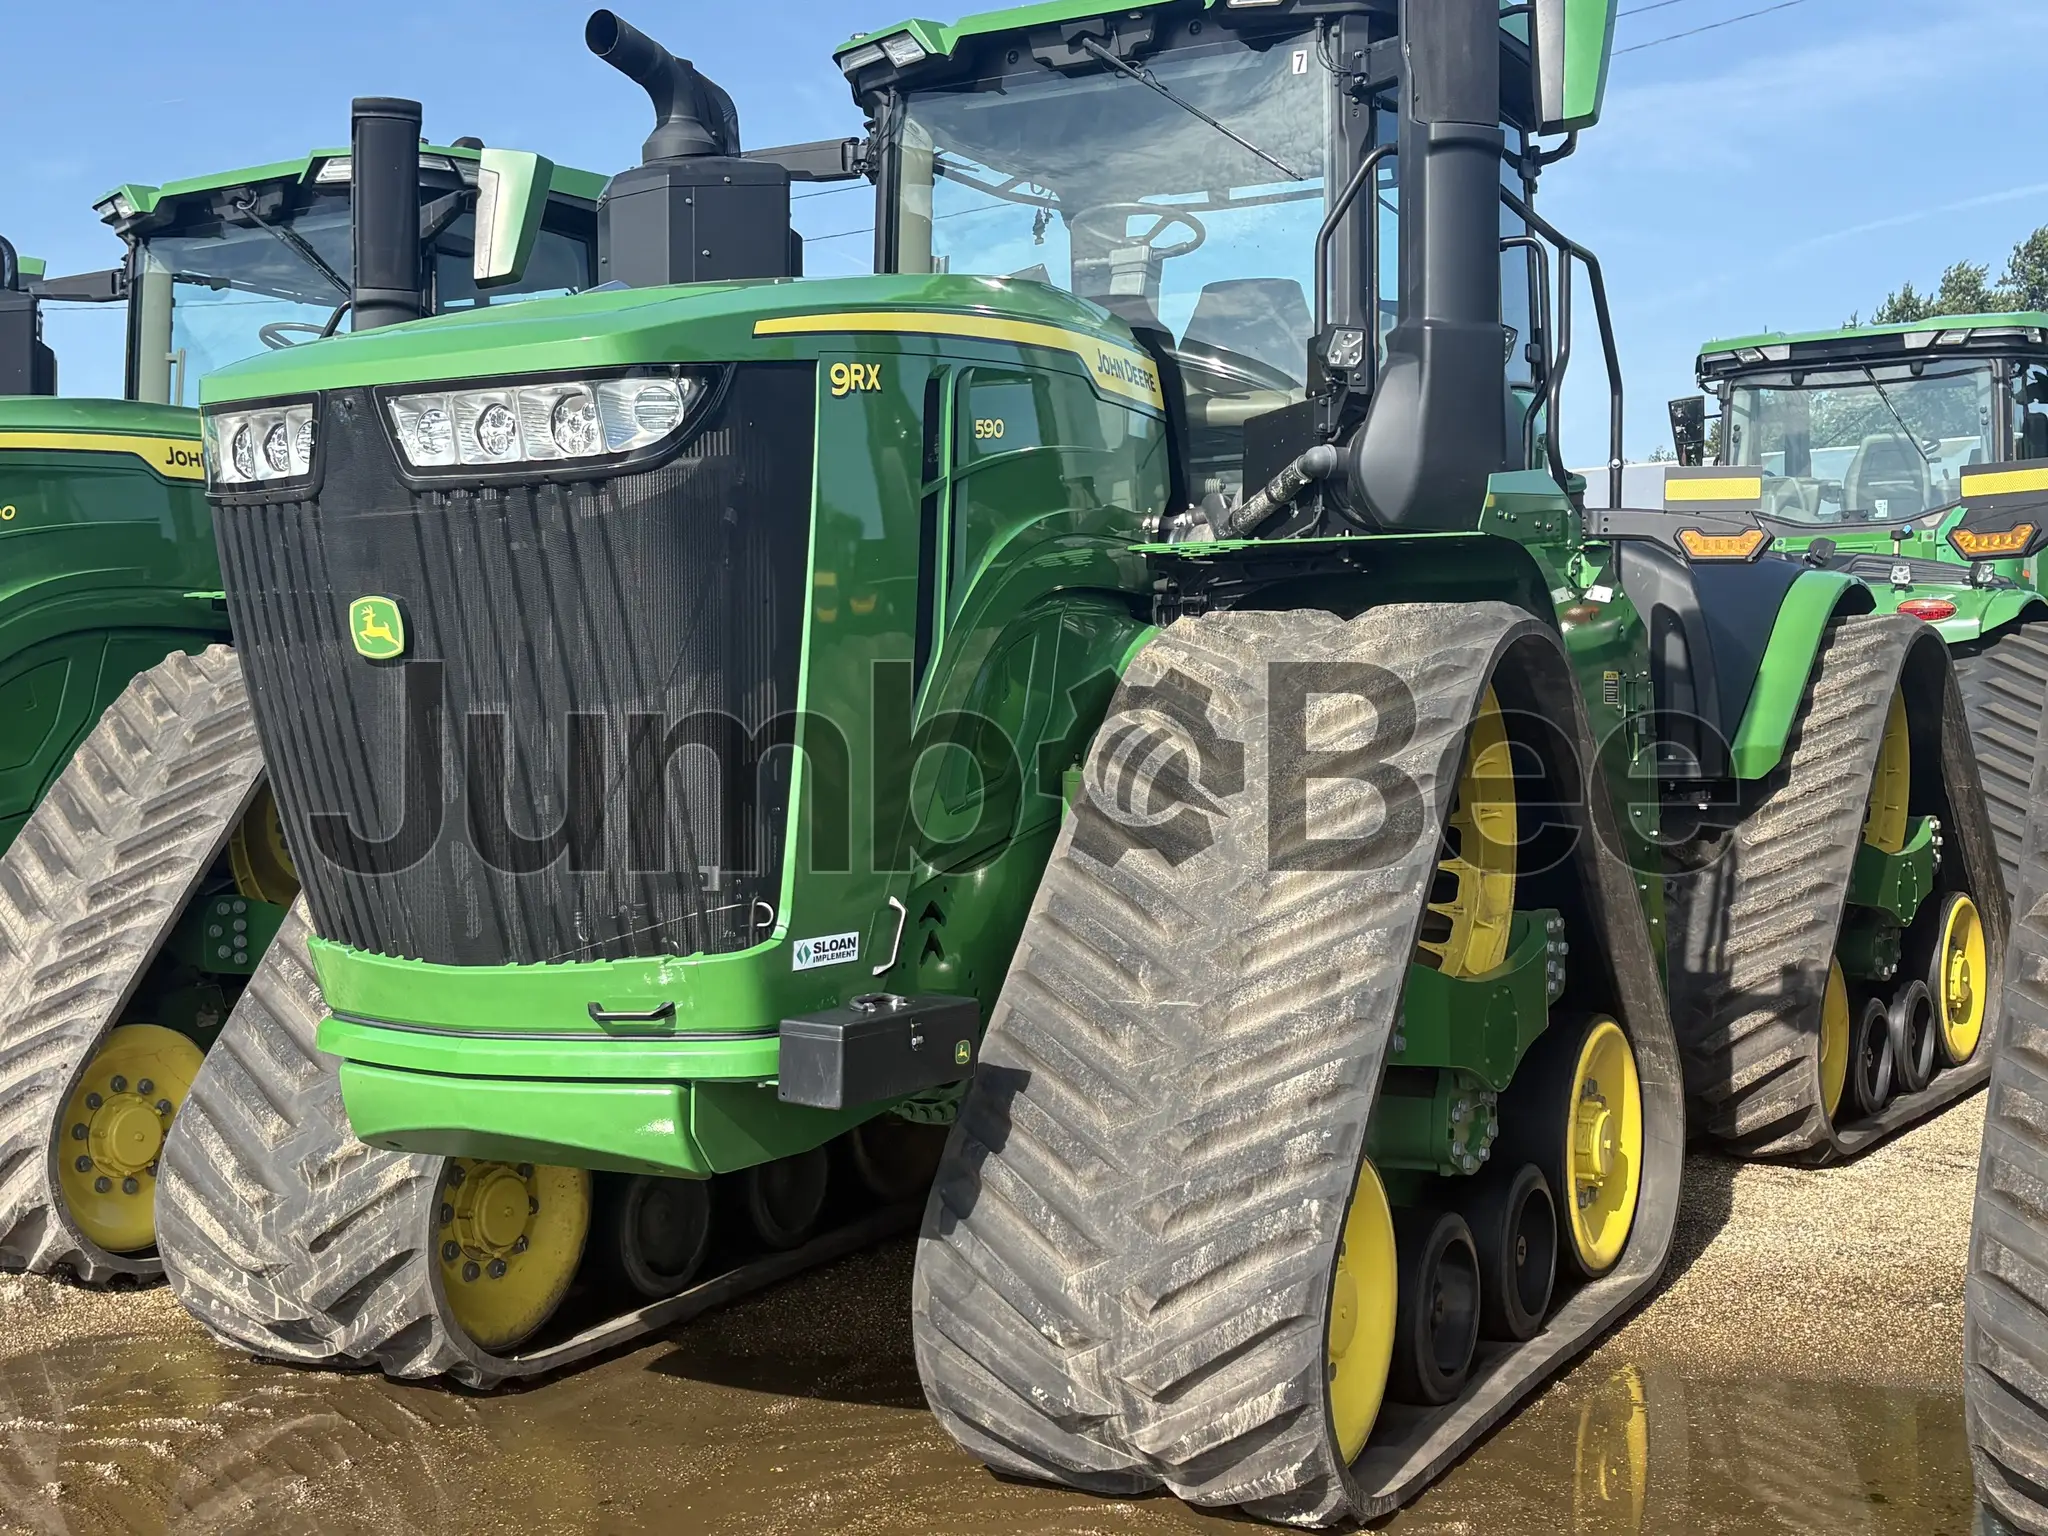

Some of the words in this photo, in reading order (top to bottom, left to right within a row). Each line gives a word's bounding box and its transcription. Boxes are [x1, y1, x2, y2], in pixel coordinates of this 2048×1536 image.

[1295, 53, 1304, 72] 7
[829, 361, 883, 398] 9RX
[1097, 348, 1126, 380] JOHN
[1124, 357, 1157, 393] DEERE
[974, 418, 1005, 440] 590
[165, 446, 205, 469] JOH
[813, 936, 857, 954] SLOAN
[813, 949, 857, 964] IMPLEMENT
